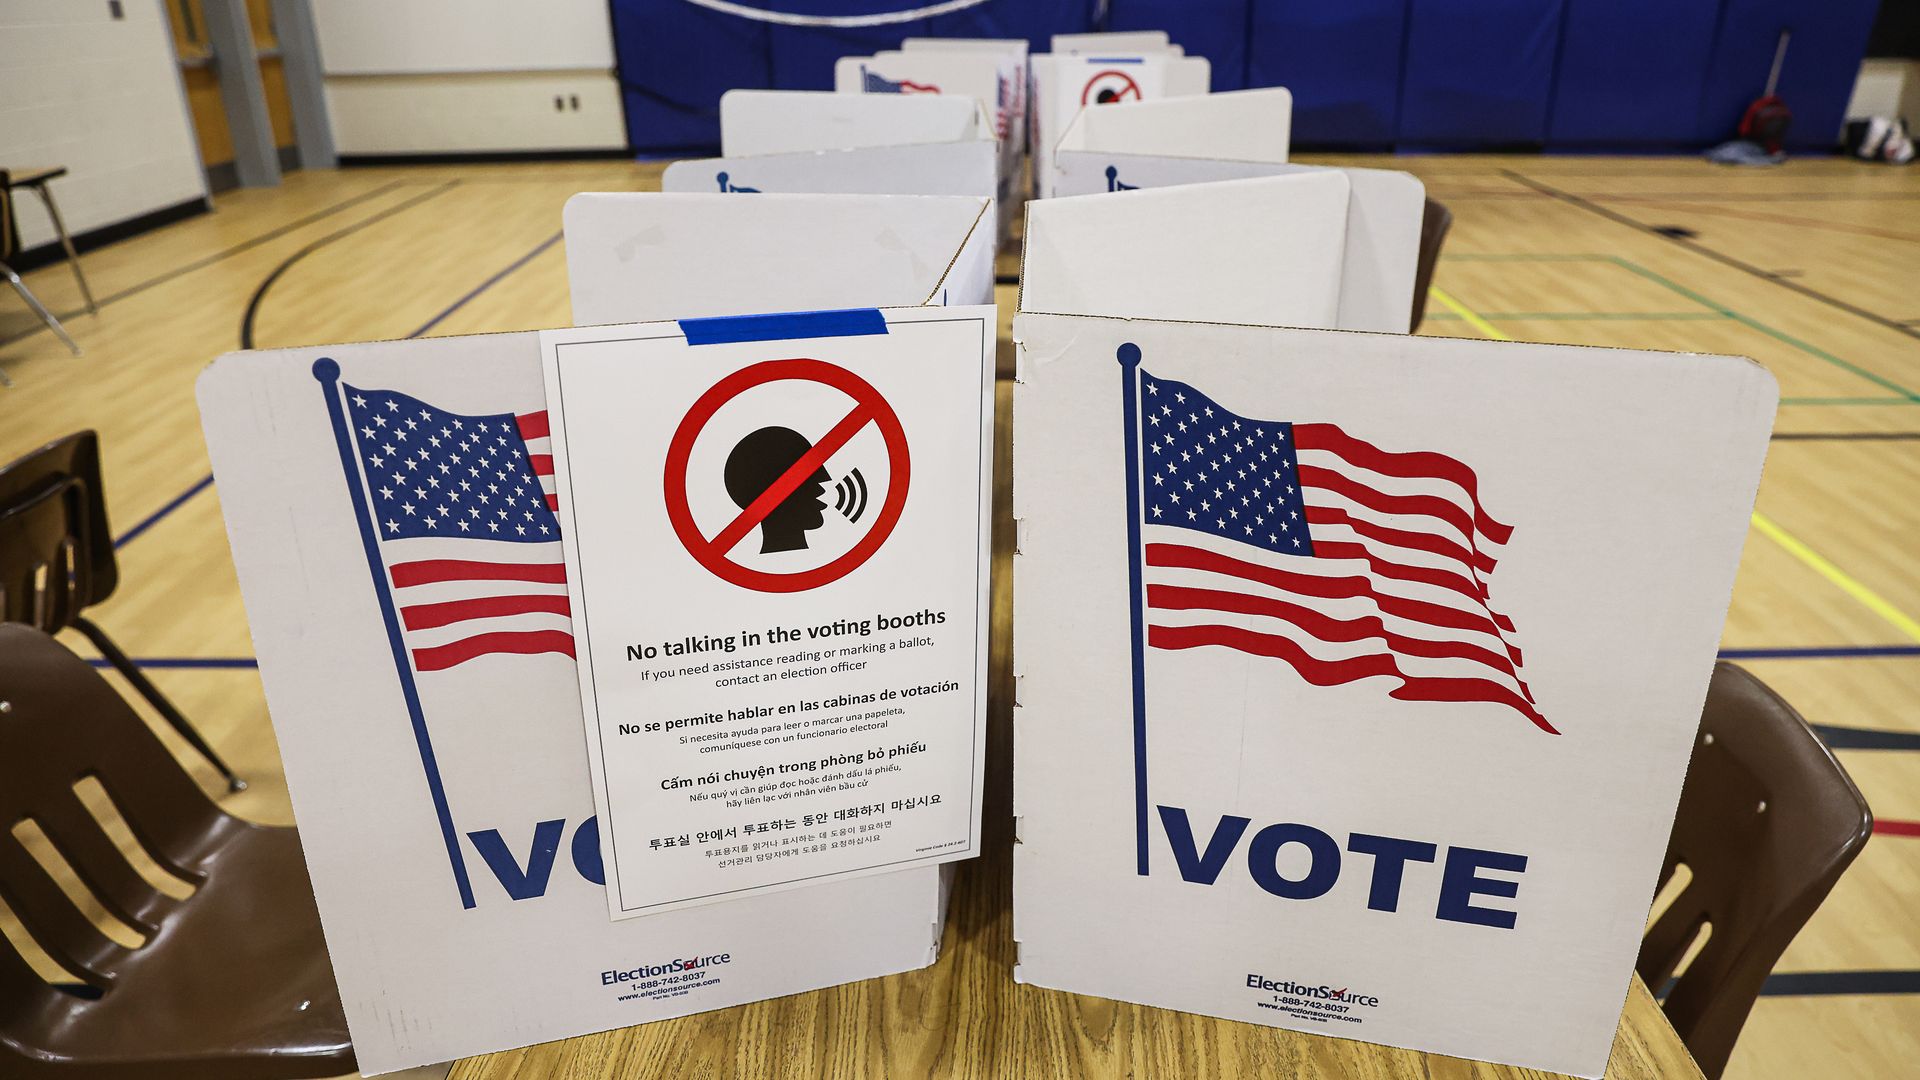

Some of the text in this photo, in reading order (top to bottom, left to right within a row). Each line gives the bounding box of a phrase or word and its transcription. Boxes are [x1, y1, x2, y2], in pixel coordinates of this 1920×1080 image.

[626, 609, 946, 661] No talking in the voting booths
[641, 636, 934, 682] If you need assistance reading or marking a ballot,
[715, 661, 867, 688] contact an election officer
[618, 680, 959, 736] No se permite hablar en las cabinas de votación
[679, 735, 688, 744] Si
[690, 731, 729, 743] necesita
[731, 726, 759, 739] ayuda
[761, 725, 782, 735] para
[783, 722, 802, 730] leer
[812, 716, 844, 727] marcar
[845, 713, 863, 722] una
[864, 708, 905, 721] papeleta,
[763, 737, 781, 745] con
[782, 735, 795, 743] un
[796, 726, 848, 740] funcionario
[849, 720, 888, 733] electoral
[661, 741, 926, 790] Cấm nói chuyện trong phòng bỏ phiếu
[649, 794, 942, 851] 투표실 안에서 투표하는 동안 대화하지 마십시요
[1156, 805, 1529, 930] VOTE
[617, 978, 720, 1002] www.electionsource.com
[631, 971, 706, 991] 1-888-742-8037
[1257, 1002, 1362, 1024] www.electionsource.com
[1273, 995, 1349, 1013] 1-888-742-8037
